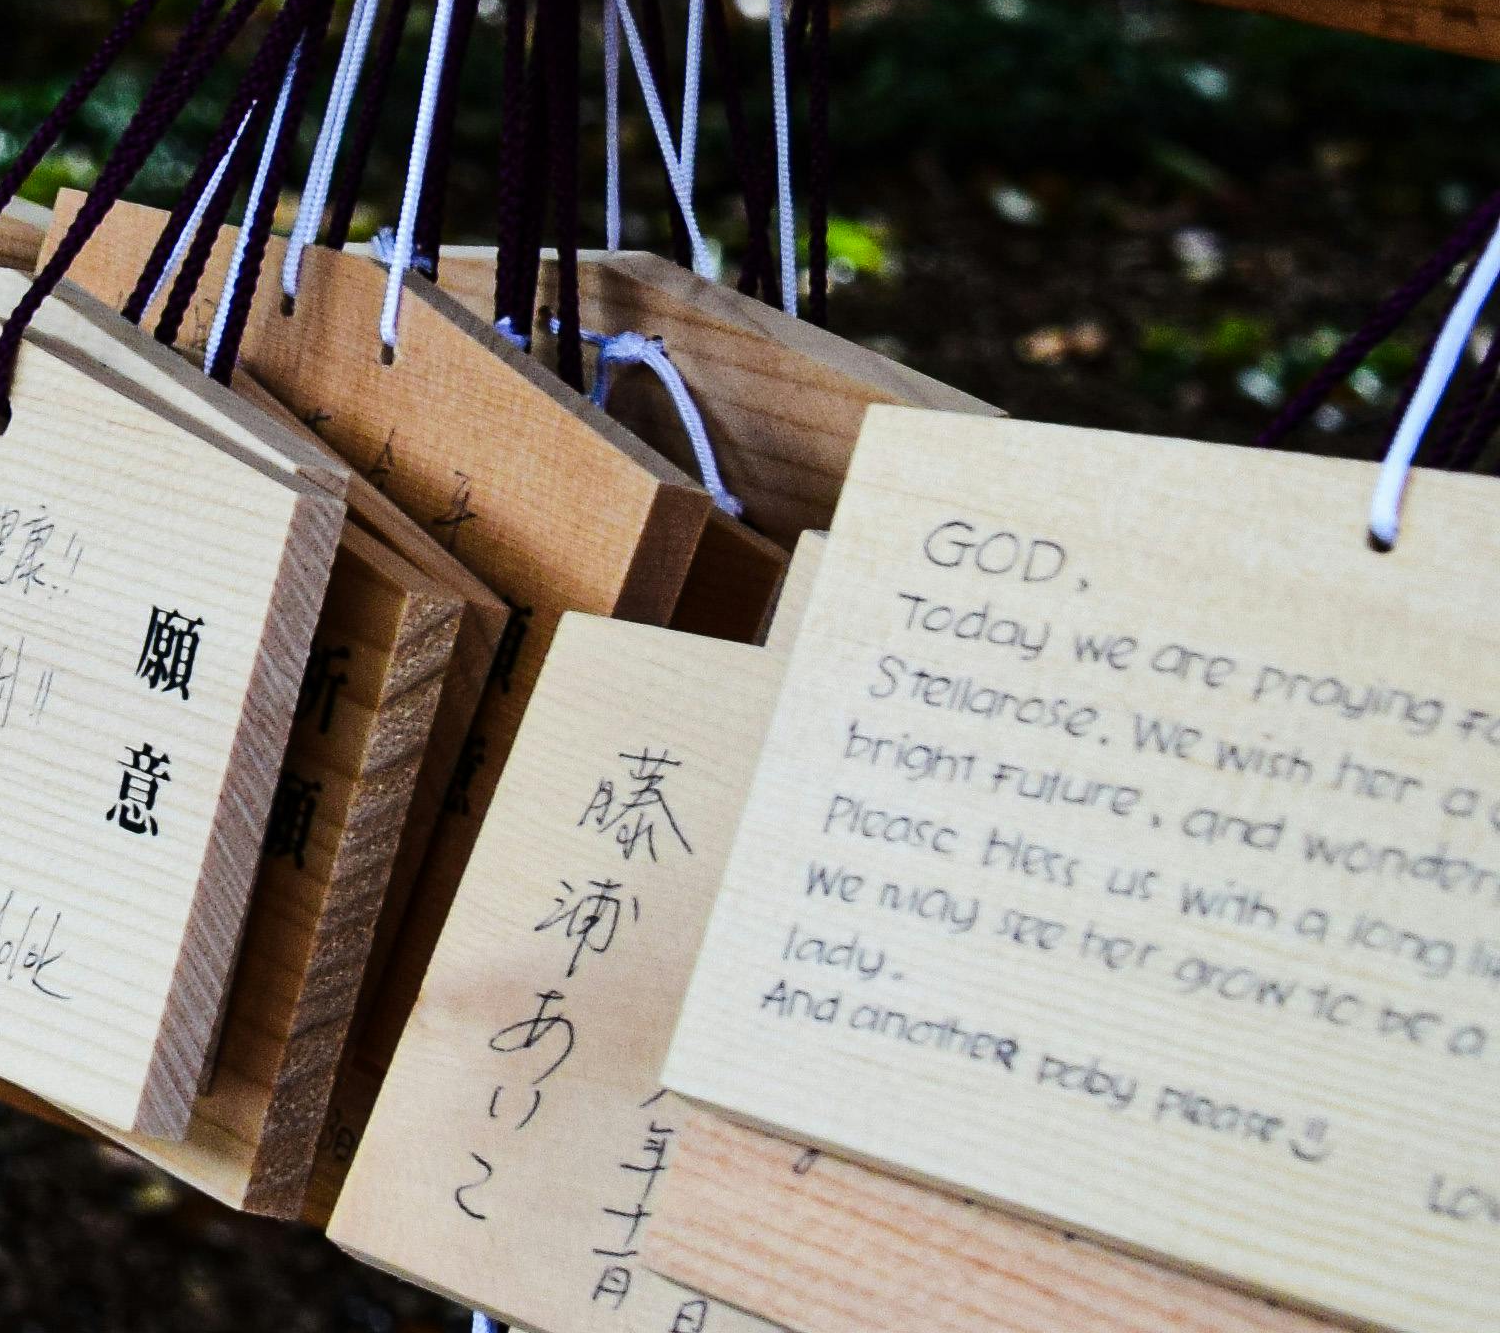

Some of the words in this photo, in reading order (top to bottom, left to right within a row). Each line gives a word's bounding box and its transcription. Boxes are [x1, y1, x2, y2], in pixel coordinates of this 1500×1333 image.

[105, 605, 207, 838] 願意
[897, 589, 1052, 663] Today
[1072, 631, 1138, 672] we
[1149, 641, 1238, 689] are
[1251, 661, 1444, 736] praying
[843, 720, 976, 783] bright
[1182, 803, 1288, 853] and
[1131, 712, 1203, 763] We
[1213, 733, 1315, 787] wish
[1330, 750, 1424, 805] her
[1441, 781, 1482, 820] a
[780, 923, 906, 984] lady.
[823, 794, 963, 860] Please
[982, 827, 1085, 890] bless
[1105, 865, 1160, 904] us
[1179, 879, 1282, 936] with
[1295, 908, 1331, 944] a
[1347, 912, 1459, 980] long
[452, 746, 695, 1222] 藤浦あいこ
[876, 877, 984, 935] may
[993, 908, 1063, 954] see
[1078, 923, 1163, 974] her
[1173, 954, 1298, 1008] grow
[1307, 984, 1367, 1029] to
[1380, 1005, 1447, 1048] be
[1447, 1021, 1490, 1059] a
[758, 977, 841, 1027] And
[1034, 1049, 1142, 1109] baby
